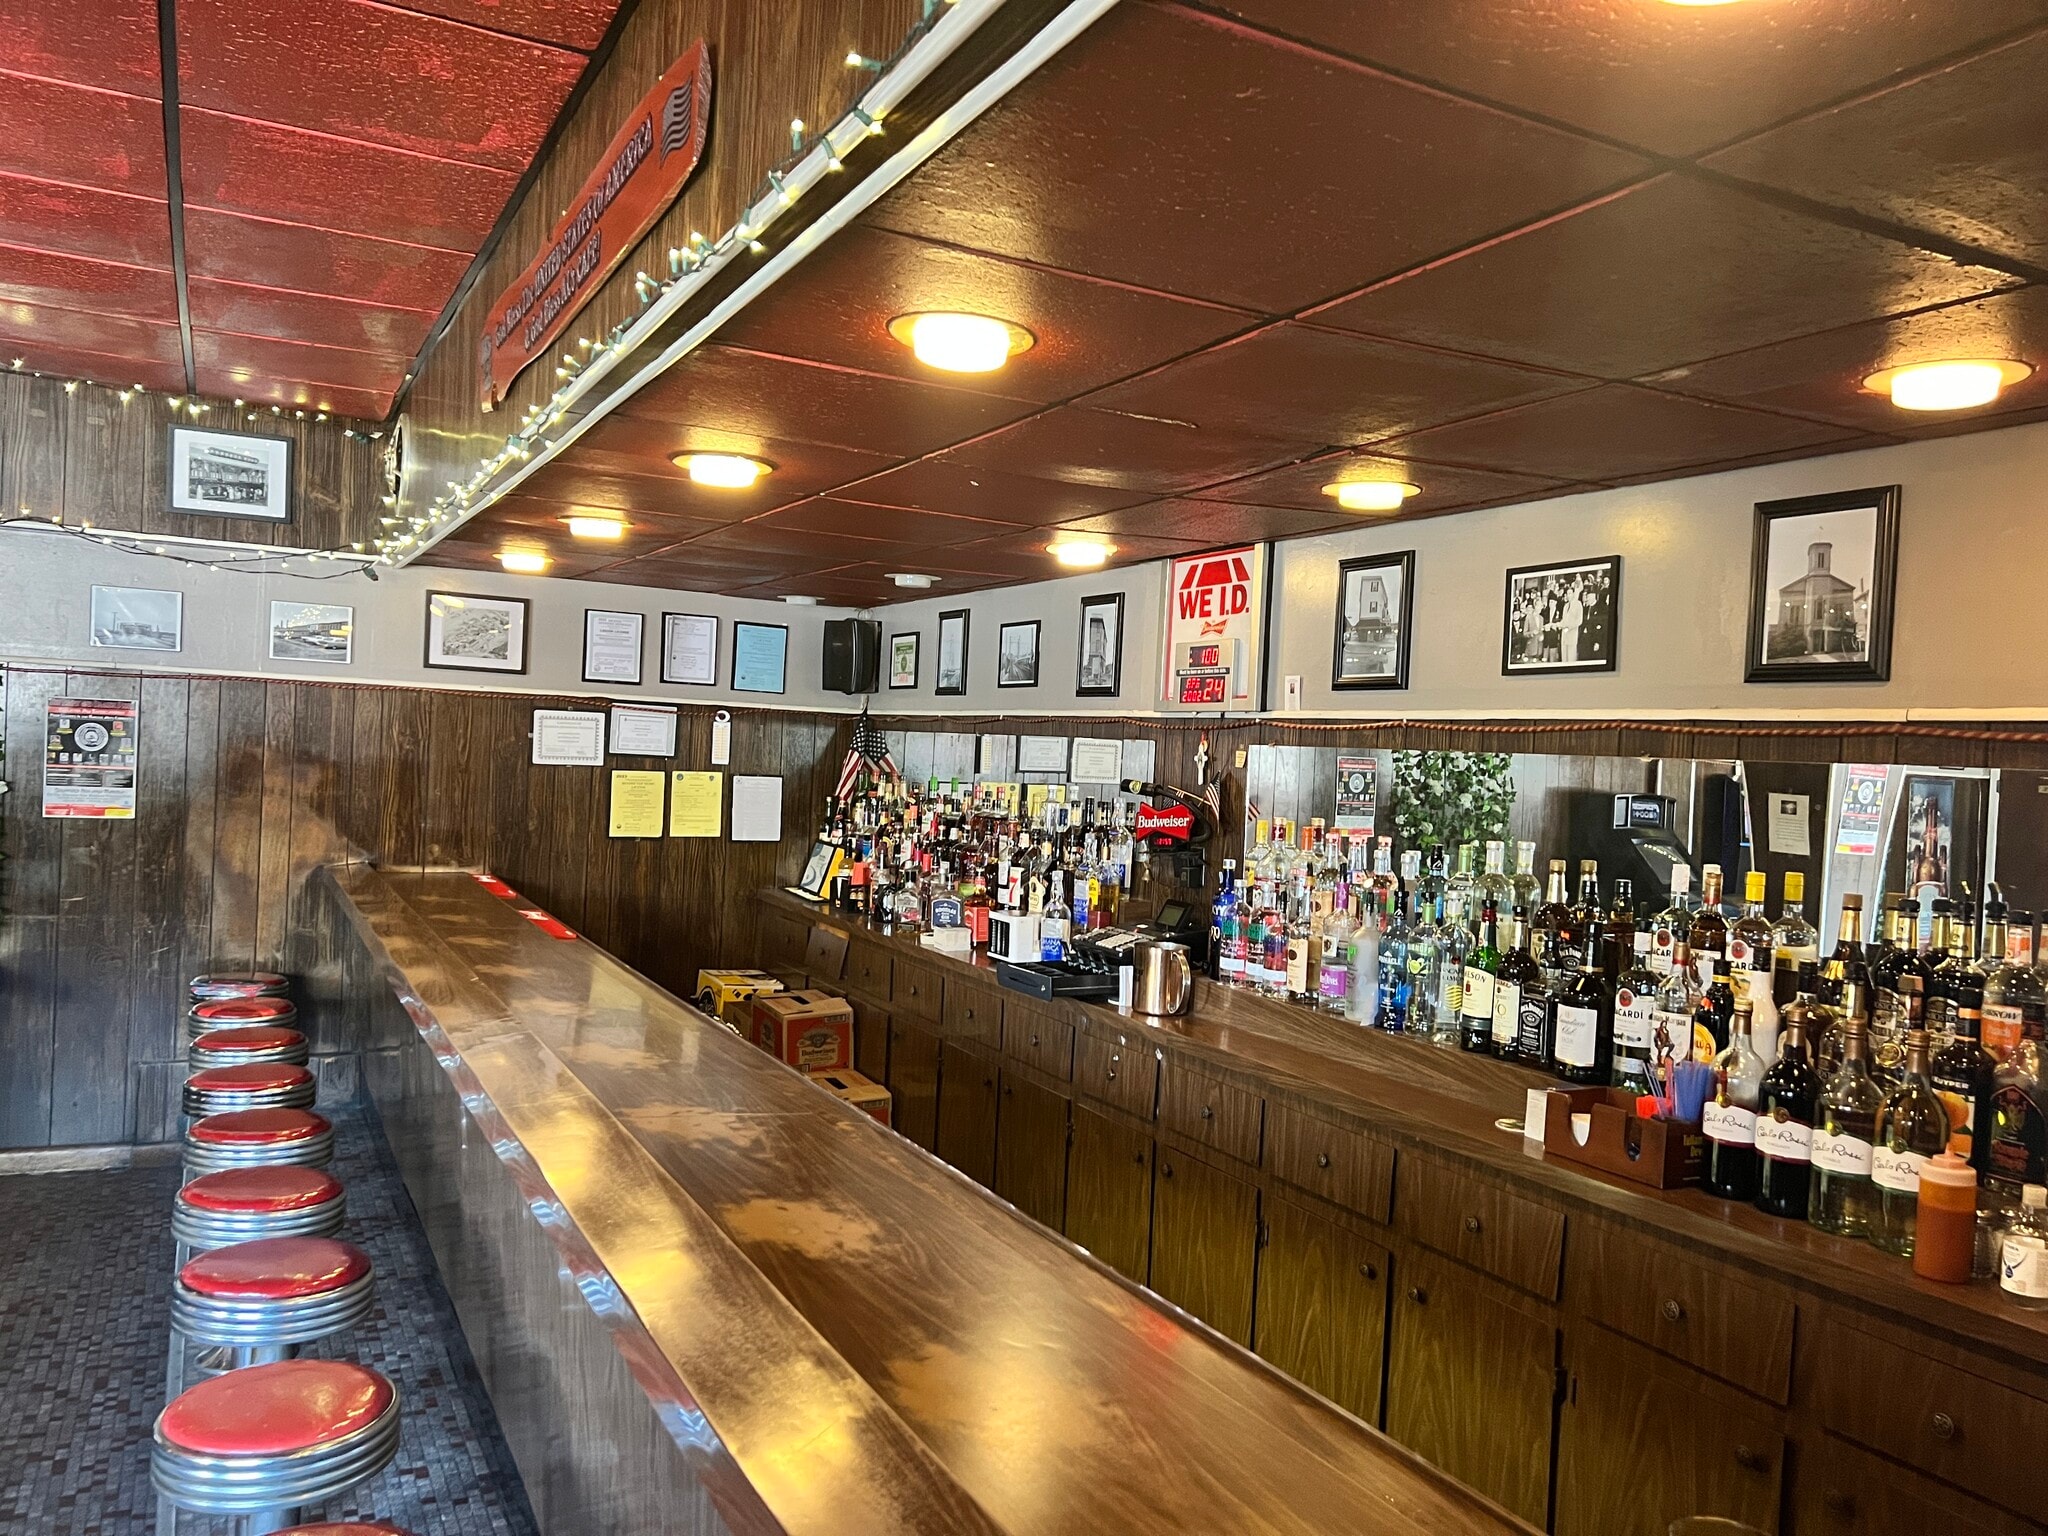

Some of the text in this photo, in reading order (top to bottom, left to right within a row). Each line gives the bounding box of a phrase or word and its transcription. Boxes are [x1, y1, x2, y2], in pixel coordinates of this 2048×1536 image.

[534, 241, 561, 301] UNITED
[560, 194, 593, 267] STATES
[603, 111, 653, 209] AMERICA
[1179, 584, 1250, 620] WE I.D.
[1182, 690, 1202, 702] 2002
[1203, 678, 1224, 700] 24
[1137, 815, 1190, 828] Budweiser
[1874, 1000, 1899, 1012] OSTON
[1722, 1114, 1752, 1132] Rossi
[1778, 1130, 1810, 1147] Rossi
[1831, 1143, 1865, 1161] Rossi
[1895, 1161, 1920, 1176] Ros
